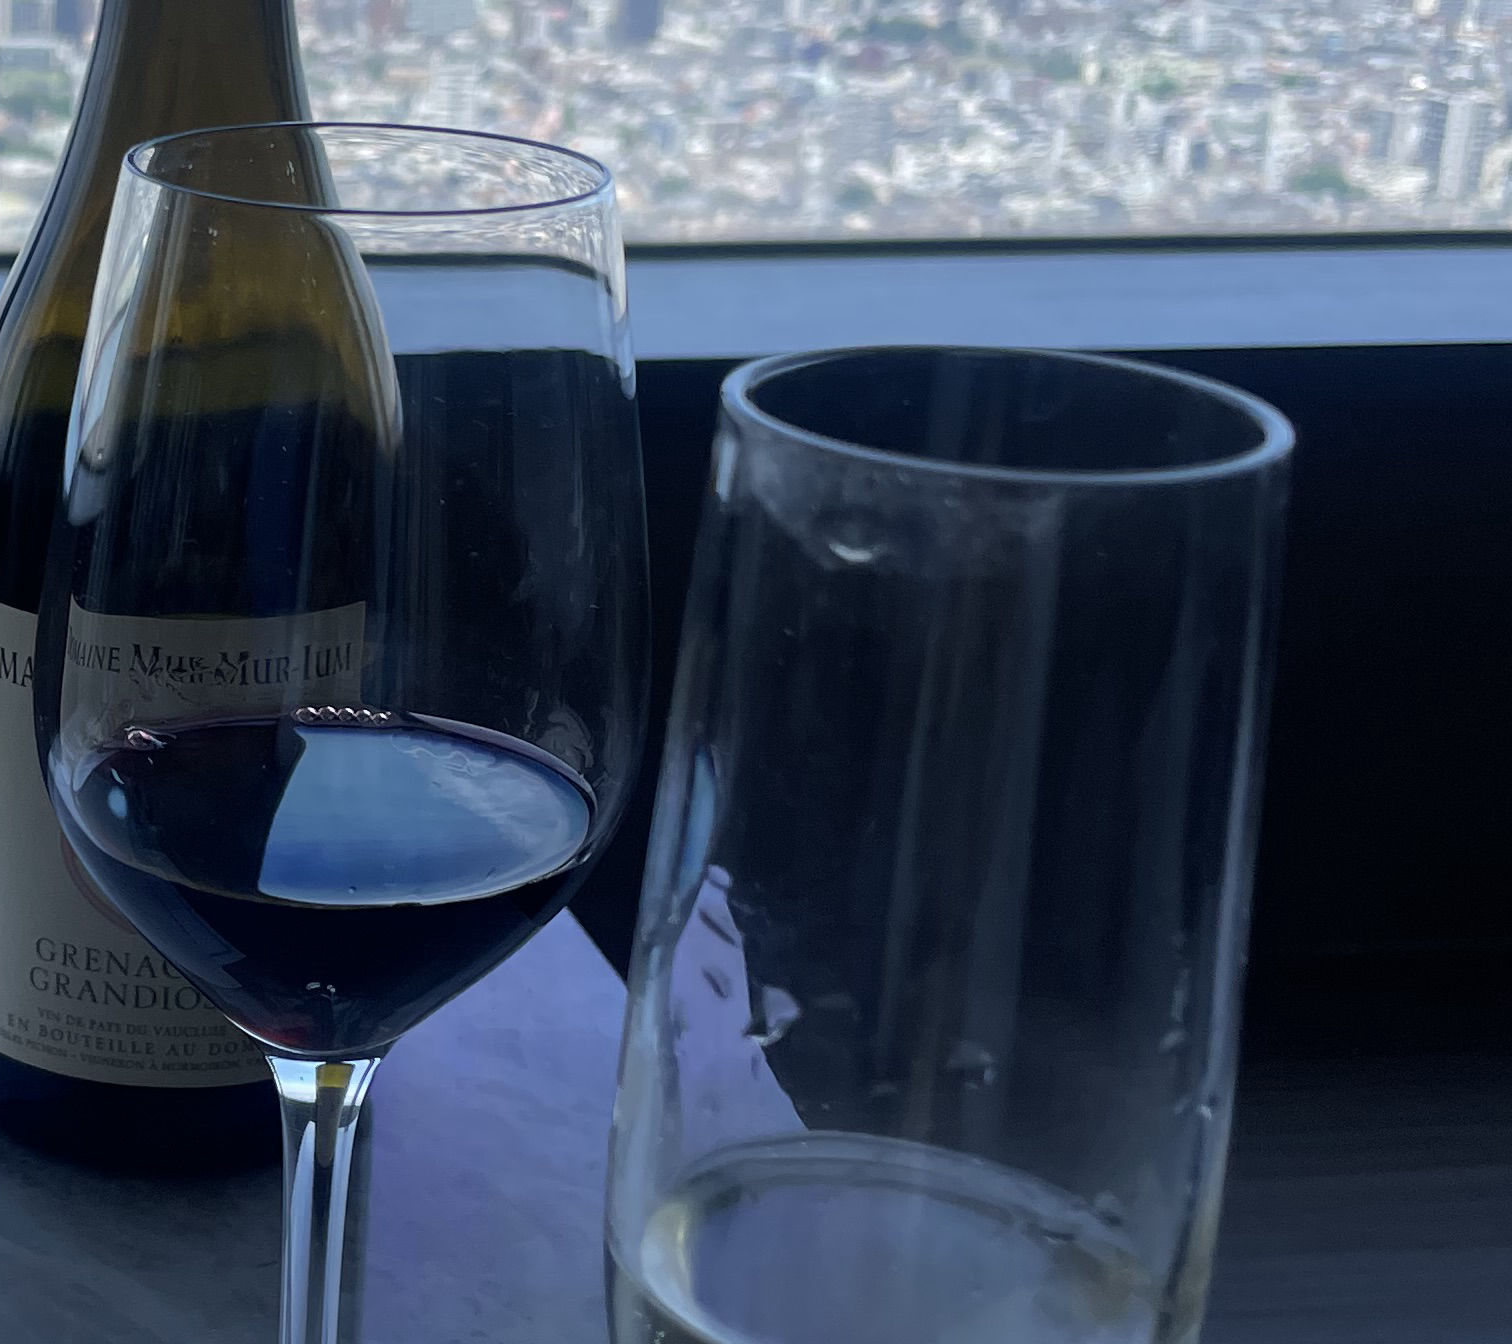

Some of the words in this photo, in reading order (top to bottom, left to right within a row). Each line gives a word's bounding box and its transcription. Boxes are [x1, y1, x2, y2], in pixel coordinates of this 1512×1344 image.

[35, 937, 181, 979] GRENAC
[30, 966, 216, 1010] GRANDIO
[7, 1013, 29, 1031] EN
[38, 1023, 155, 1055] BOUTEILLE
[167, 1043, 196, 1056] AU
